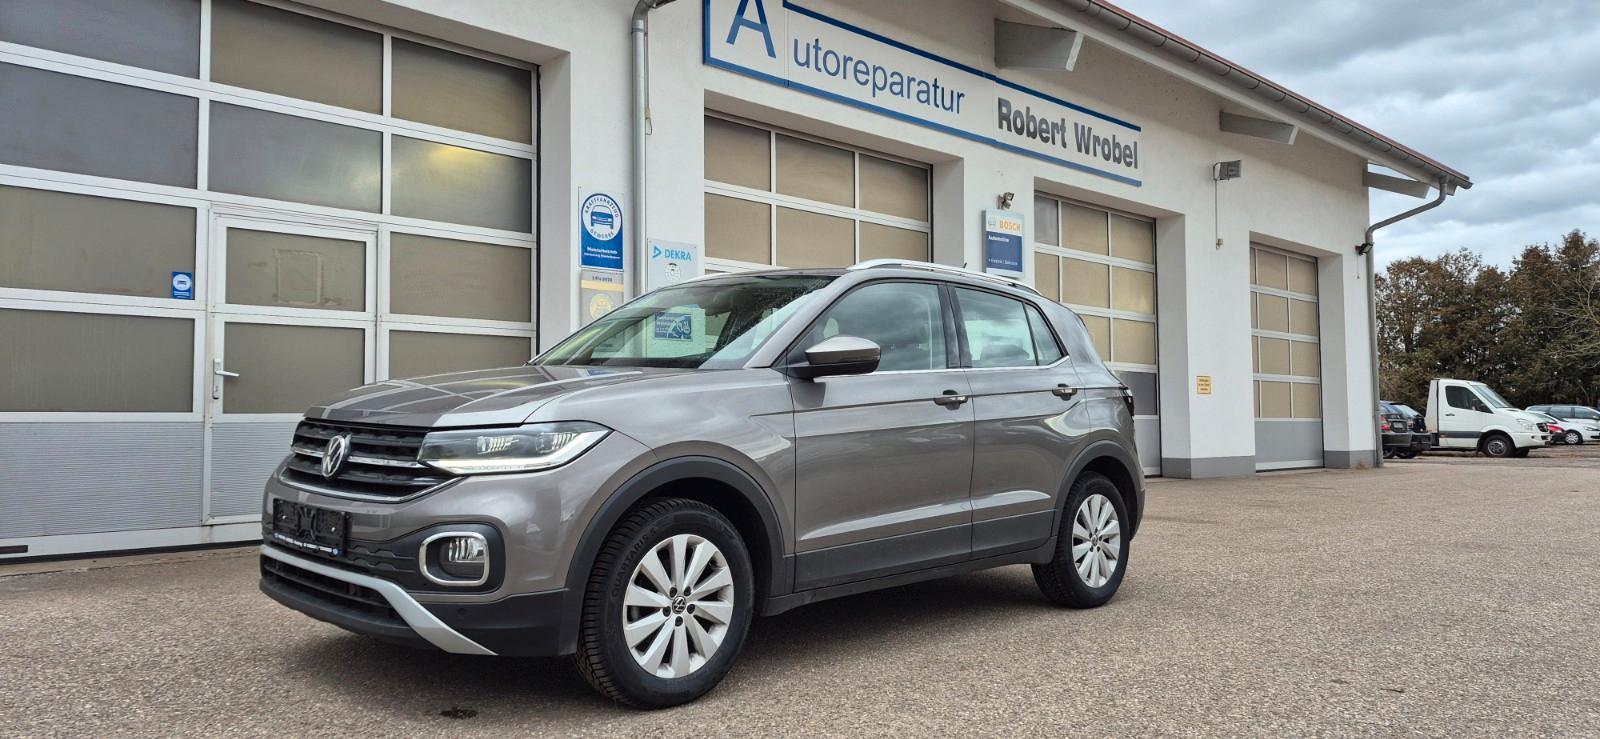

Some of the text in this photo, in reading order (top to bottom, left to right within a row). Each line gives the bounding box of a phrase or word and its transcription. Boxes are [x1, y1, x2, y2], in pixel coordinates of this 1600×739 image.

[997, 97, 1068, 149] Robert
[1074, 121, 1139, 170] Wrobel
[1000, 219, 1021, 232] BOSCH
[664, 248, 692, 261] DEKRA
